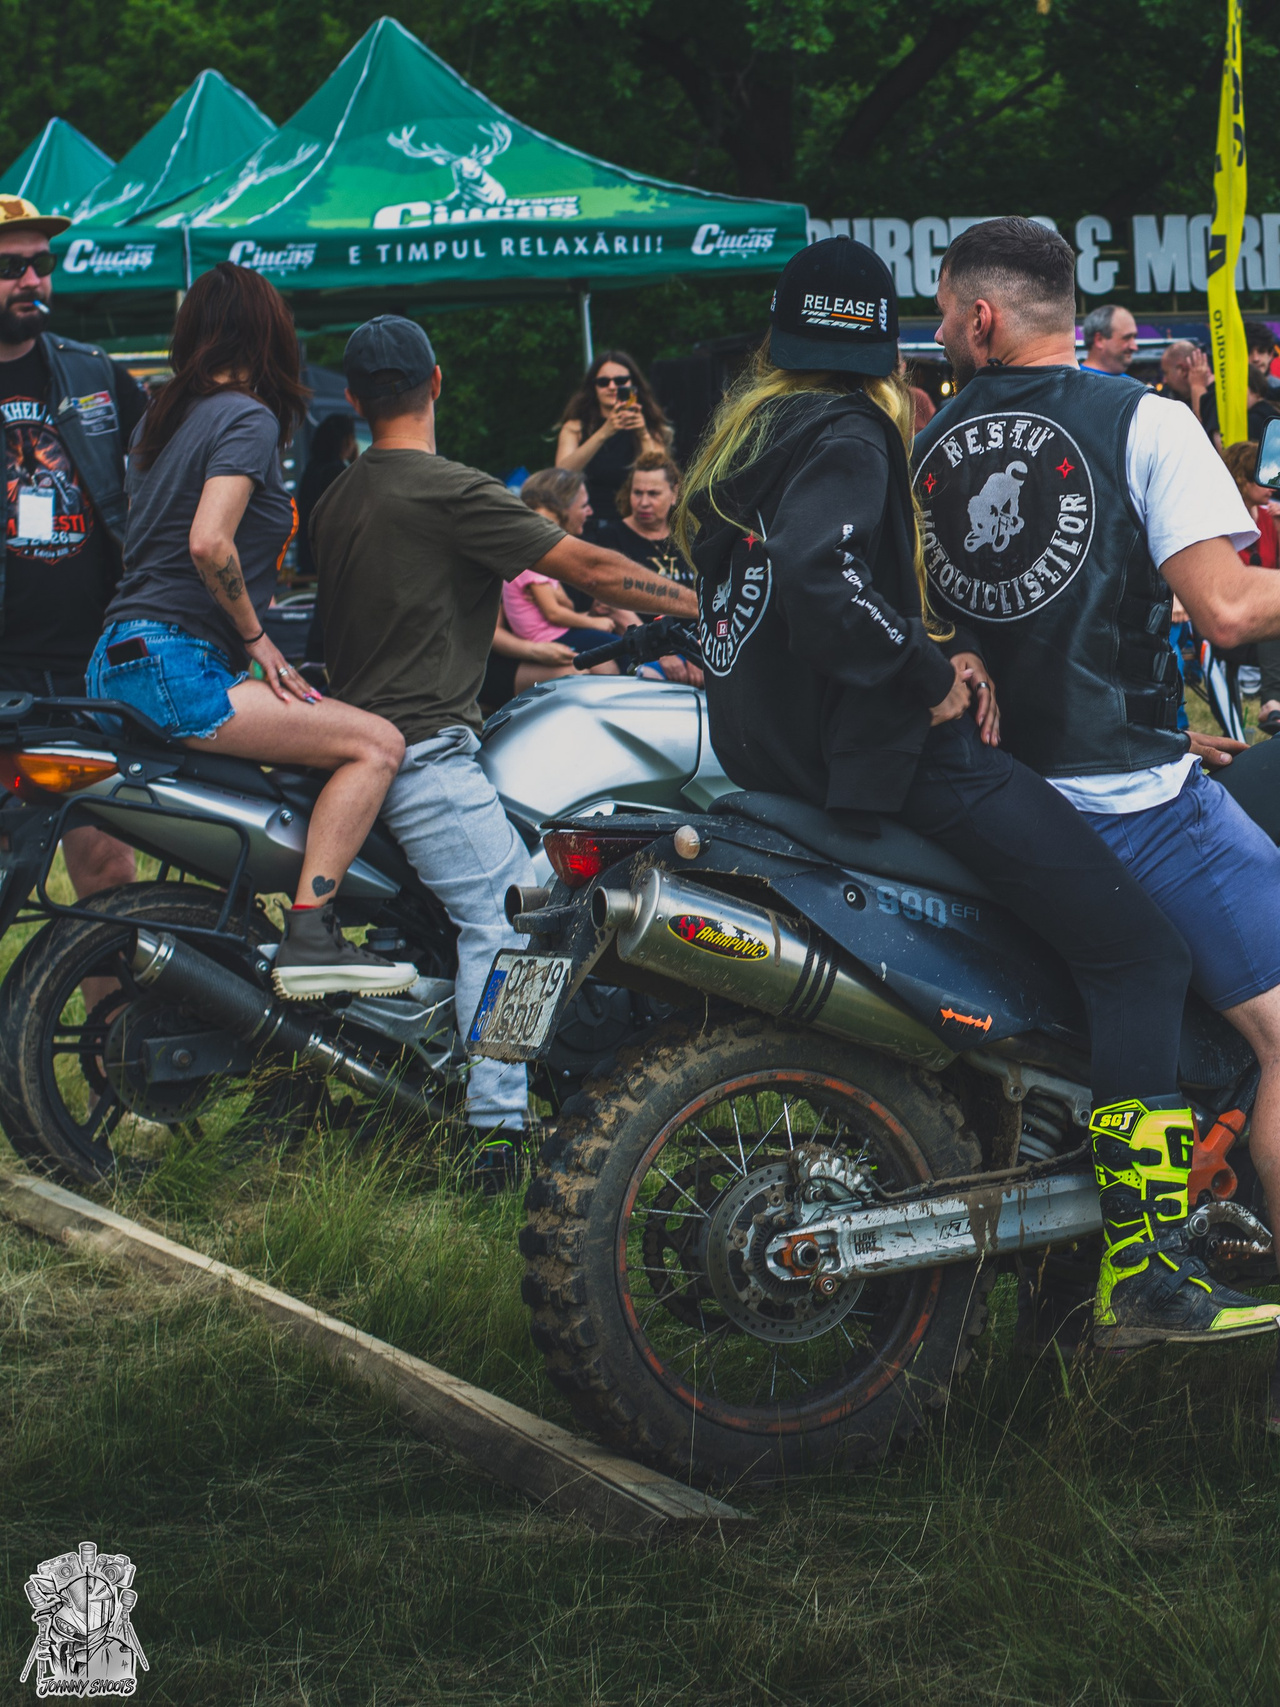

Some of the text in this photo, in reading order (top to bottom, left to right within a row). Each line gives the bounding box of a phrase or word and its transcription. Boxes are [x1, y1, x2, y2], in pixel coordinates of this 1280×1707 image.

[349, 231, 663, 265] E TIMPUL RELAXĂRII!
[800, 309, 831, 318] THE
[803, 293, 876, 318] RELEASE
[805, 317, 872, 331] BEAST
[876, 885, 981, 929] 990 EFI
[1099, 1112, 1134, 1131] SGJ
[858, 1230, 878, 1242] LOVE
